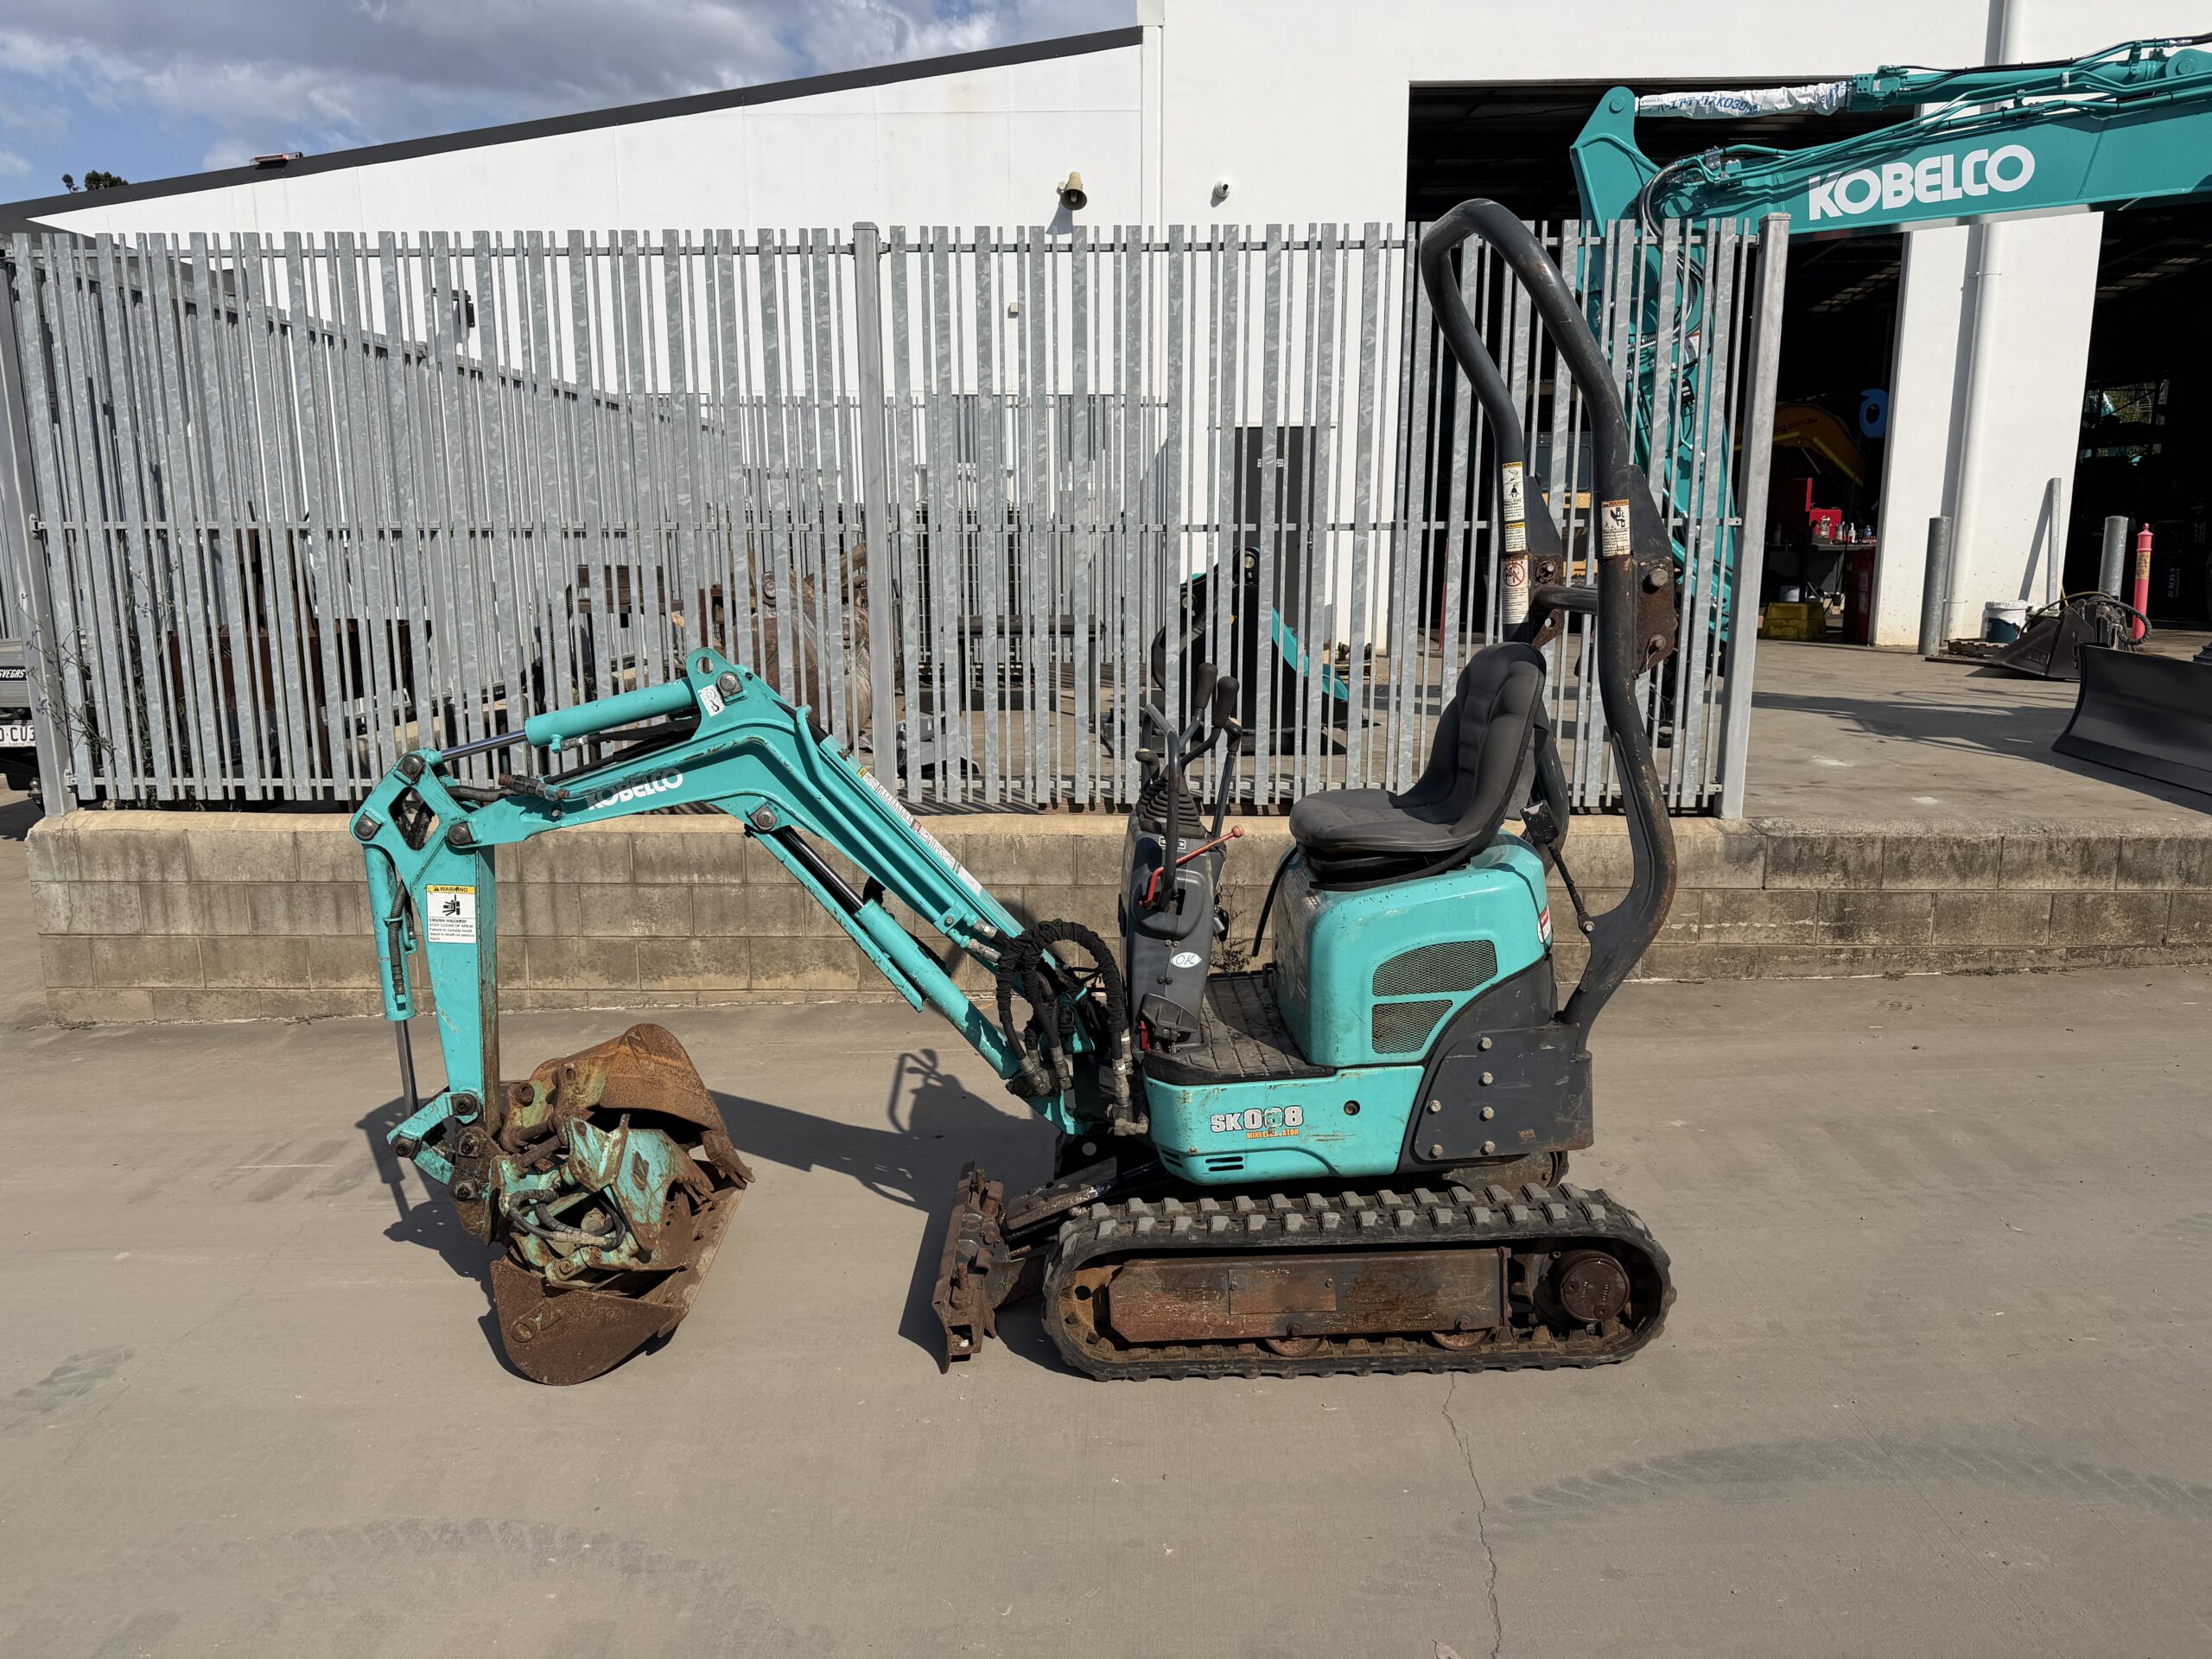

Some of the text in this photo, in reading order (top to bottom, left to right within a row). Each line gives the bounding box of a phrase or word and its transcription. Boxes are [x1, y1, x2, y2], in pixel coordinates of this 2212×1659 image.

[1808, 144, 2036, 221] KOBELCO
[585, 767, 683, 810] KOBELCO
[1176, 954, 1195, 965] OK
[1247, 1130, 1262, 1139] MINI
